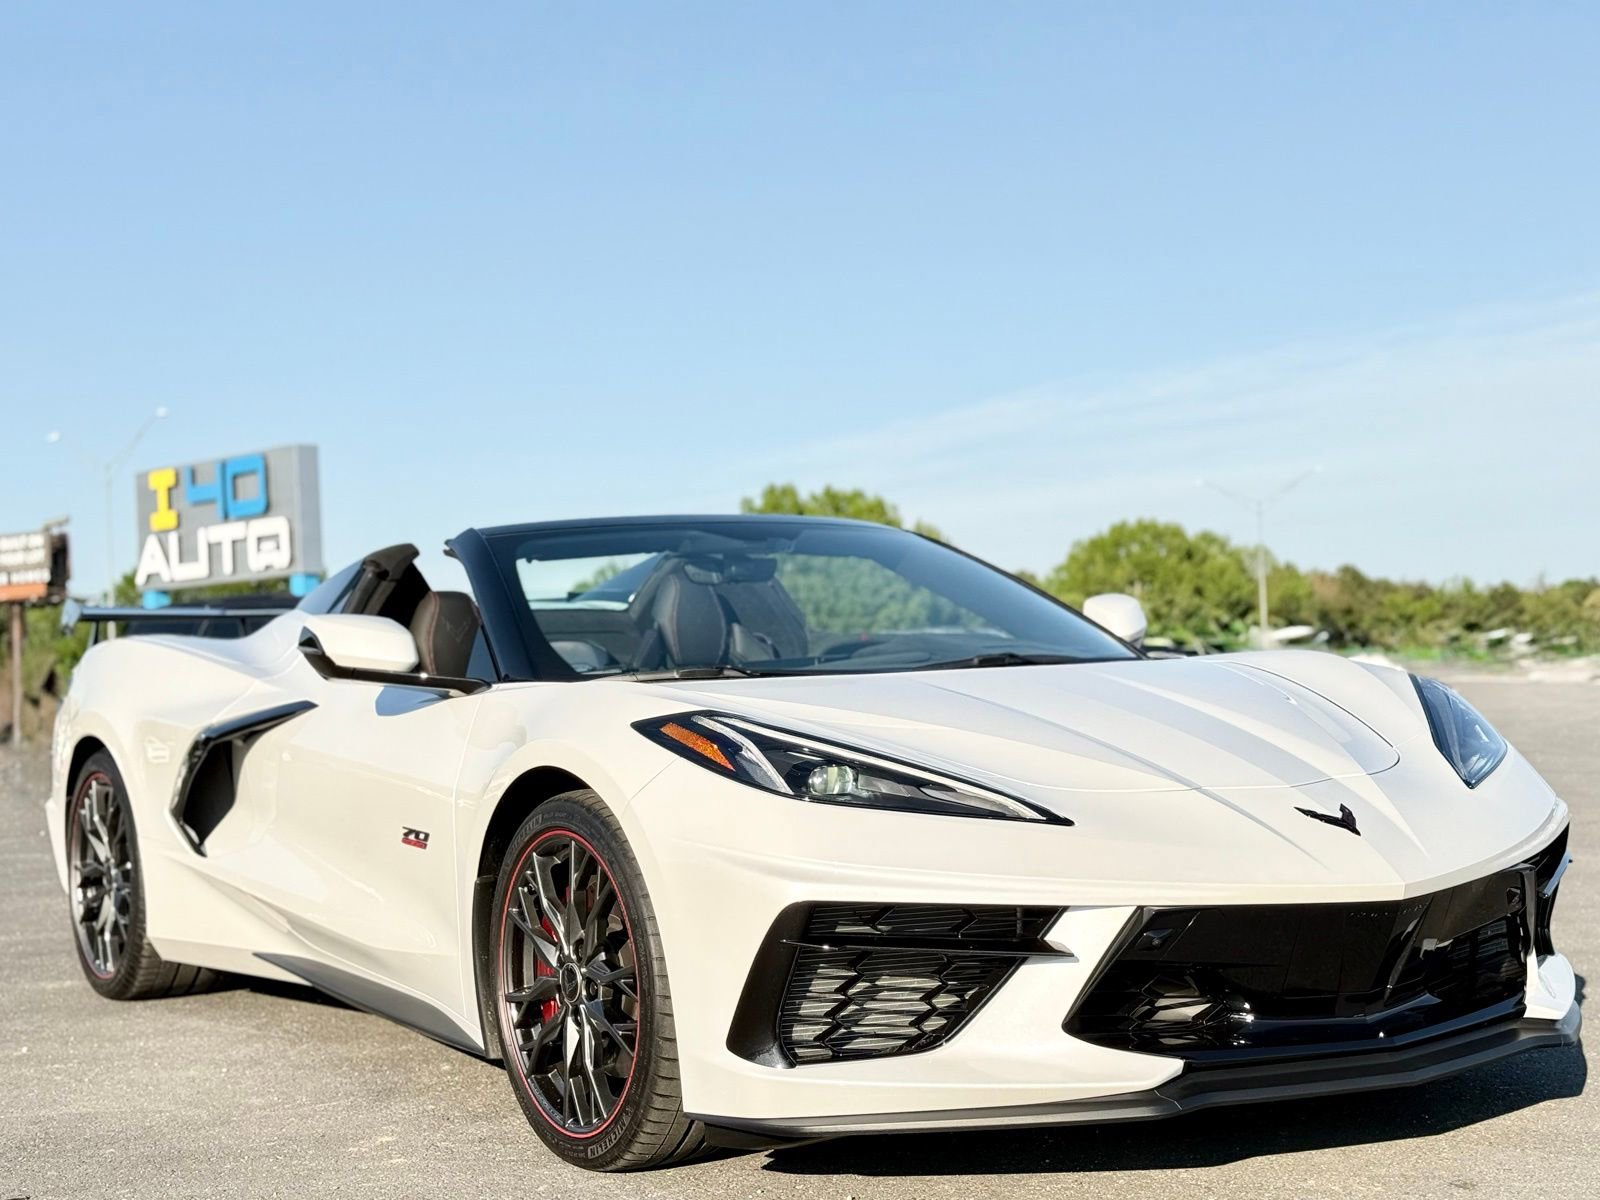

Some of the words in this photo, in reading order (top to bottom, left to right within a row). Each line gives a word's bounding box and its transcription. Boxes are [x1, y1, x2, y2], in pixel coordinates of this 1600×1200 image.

[135, 515, 292, 587] AUTO
[402, 826, 430, 843] 70
[588, 1115, 631, 1160] MICHELIN
